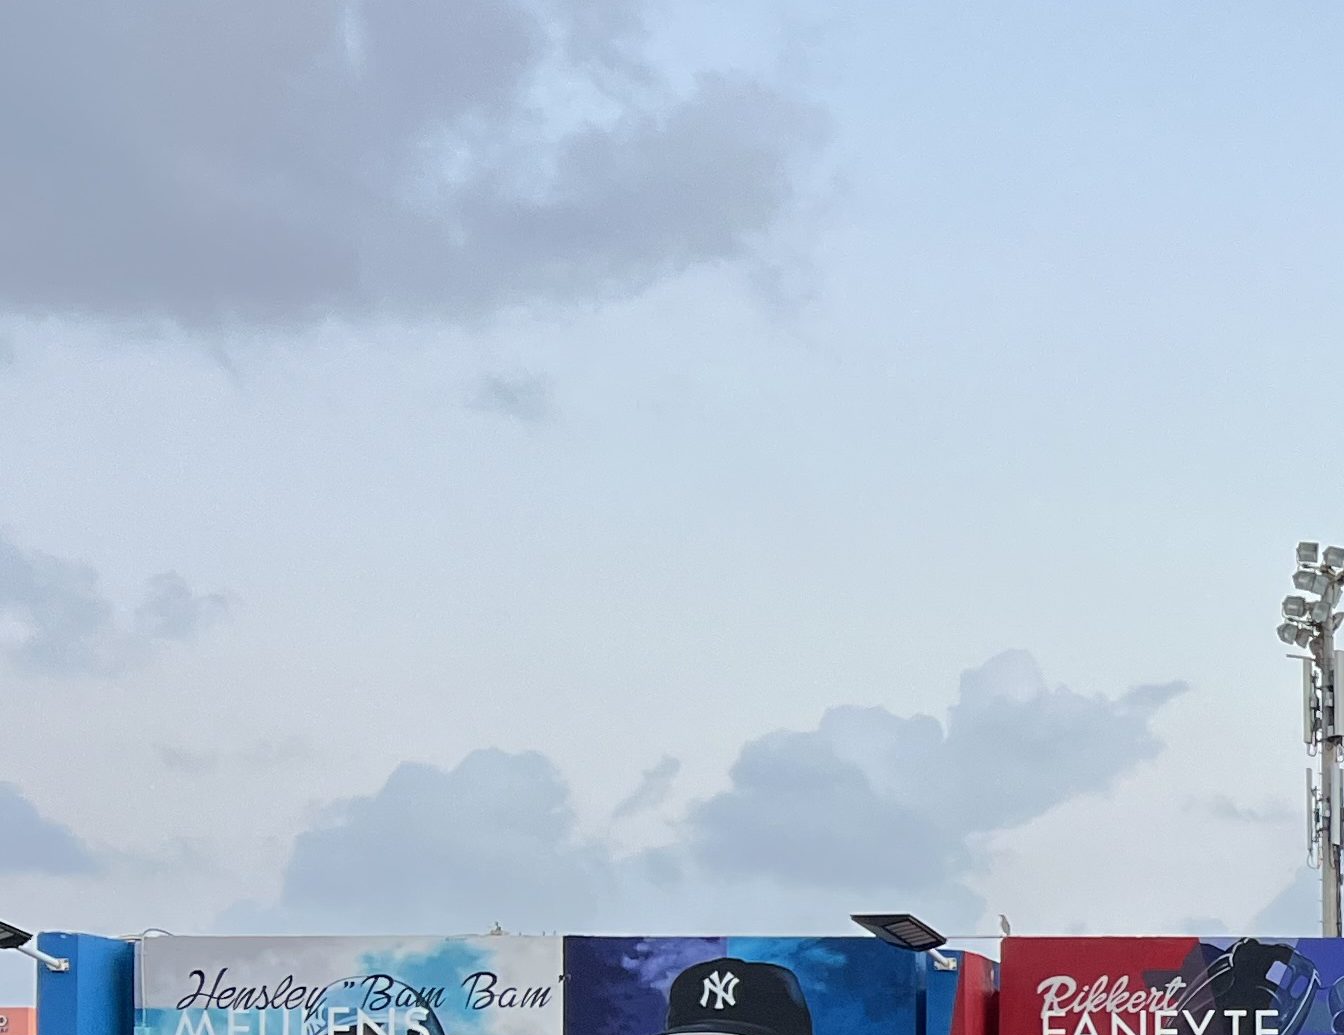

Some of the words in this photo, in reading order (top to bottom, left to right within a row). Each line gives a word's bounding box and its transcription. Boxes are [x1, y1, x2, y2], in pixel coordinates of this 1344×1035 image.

[176, 968, 328, 1023] Hensley
[344, 974, 446, 1011] "Bam
[1037, 975, 1187, 1020] Rikkert
